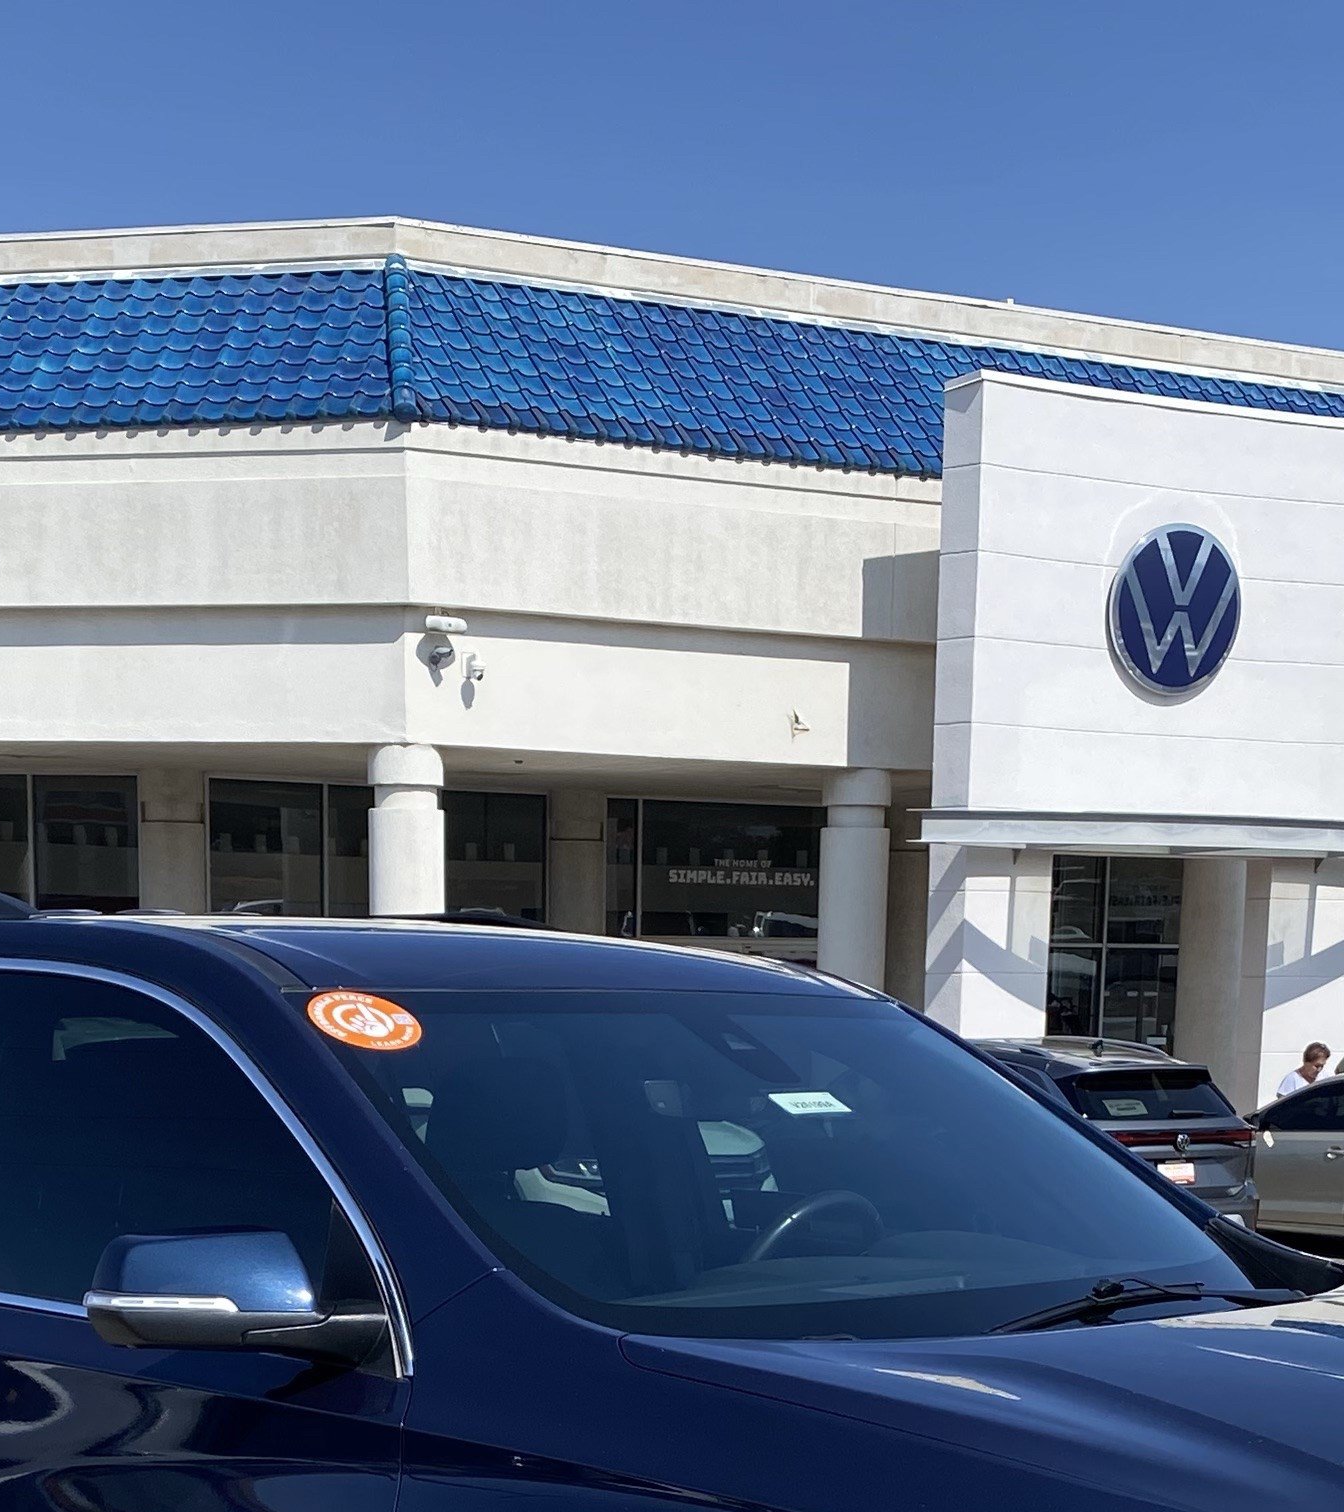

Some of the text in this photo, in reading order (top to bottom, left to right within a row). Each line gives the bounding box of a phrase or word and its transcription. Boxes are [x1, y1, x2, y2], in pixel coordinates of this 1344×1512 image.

[1116, 527, 1239, 682] VW
[714, 858, 772, 869] THE HOME OF
